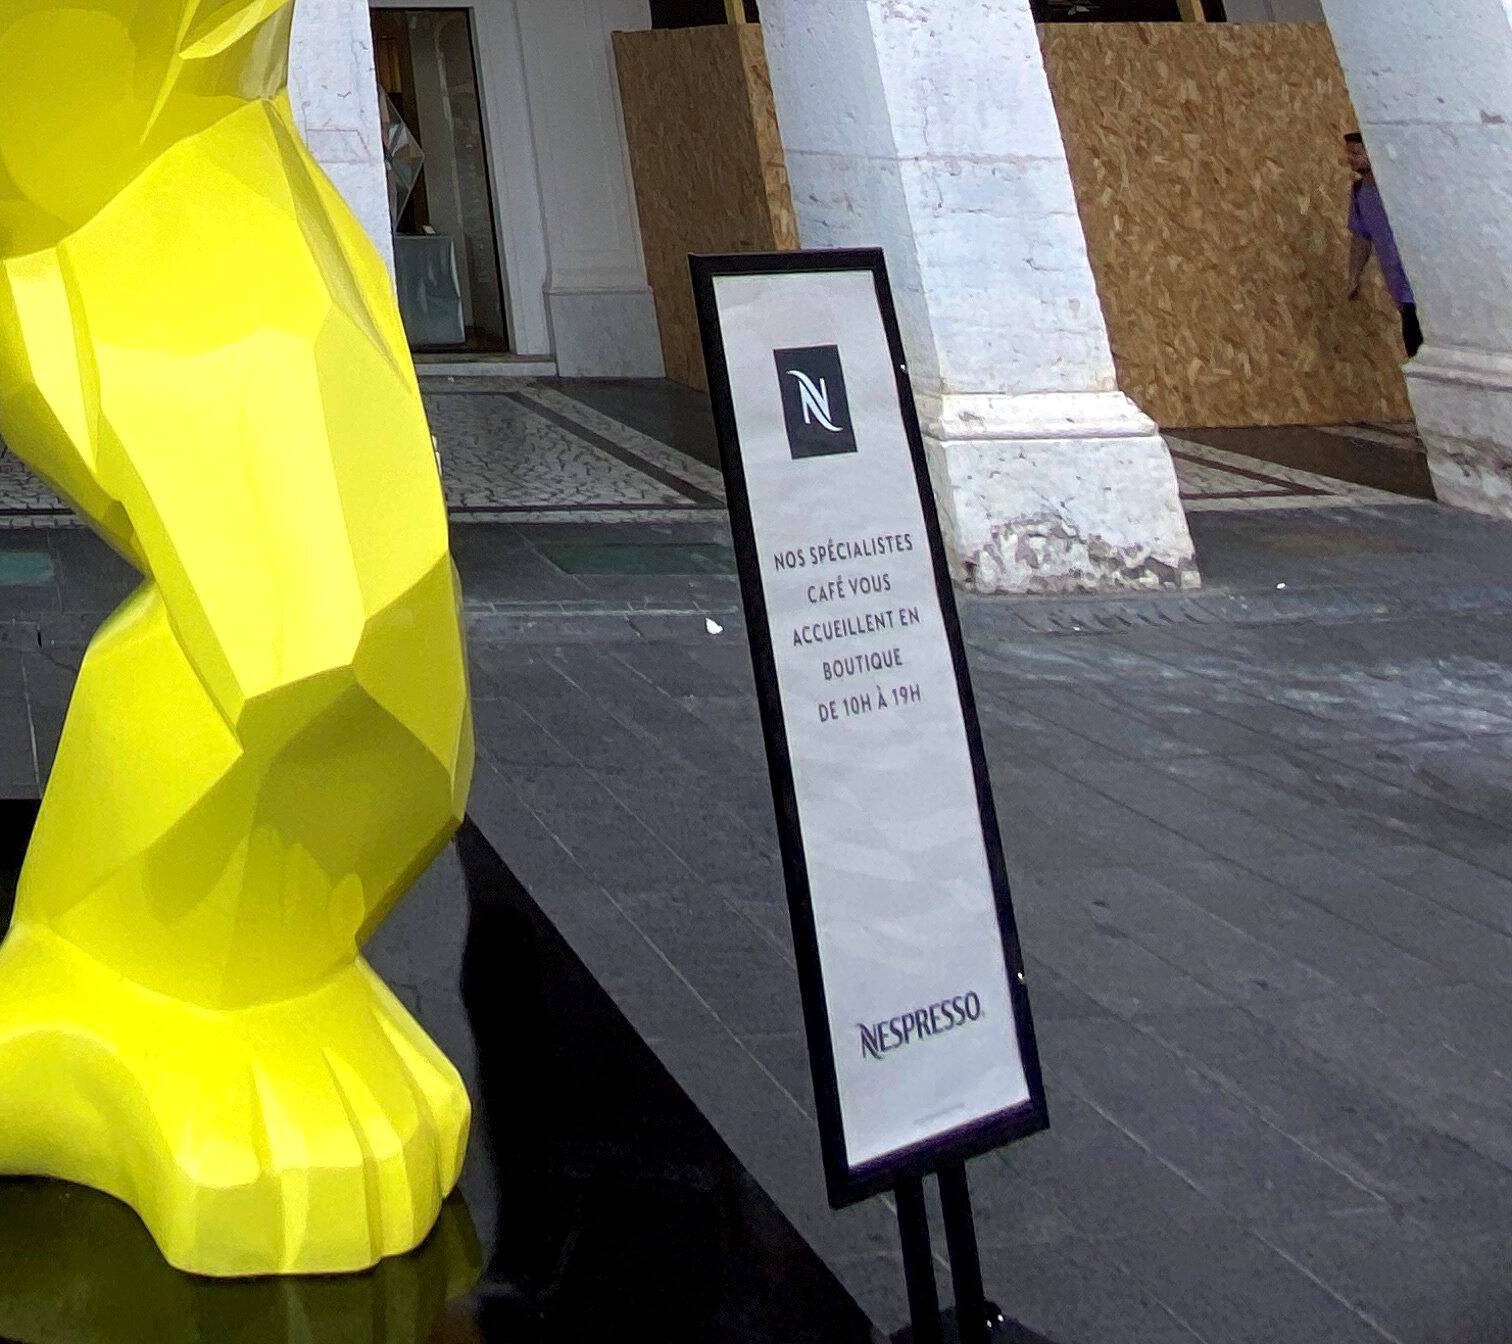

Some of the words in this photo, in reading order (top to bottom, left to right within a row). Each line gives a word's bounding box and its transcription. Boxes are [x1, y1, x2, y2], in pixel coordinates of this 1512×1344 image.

[786, 369, 843, 432] N
[774, 548, 806, 572] NOS
[809, 533, 913, 565] SPÉCIALISTES
[807, 575, 845, 604] CAFÉ
[848, 573, 892, 595] VOUS
[793, 610, 893, 647] ACCUEILLENT
[899, 606, 920, 627] EN
[822, 648, 903, 681] BOUTIQUE
[818, 700, 839, 723] DE
[843, 693, 872, 717] 10H
[877, 684, 888, 710] À
[892, 683, 920, 706] 19H
[857, 991, 982, 1061] NESPRESSO
